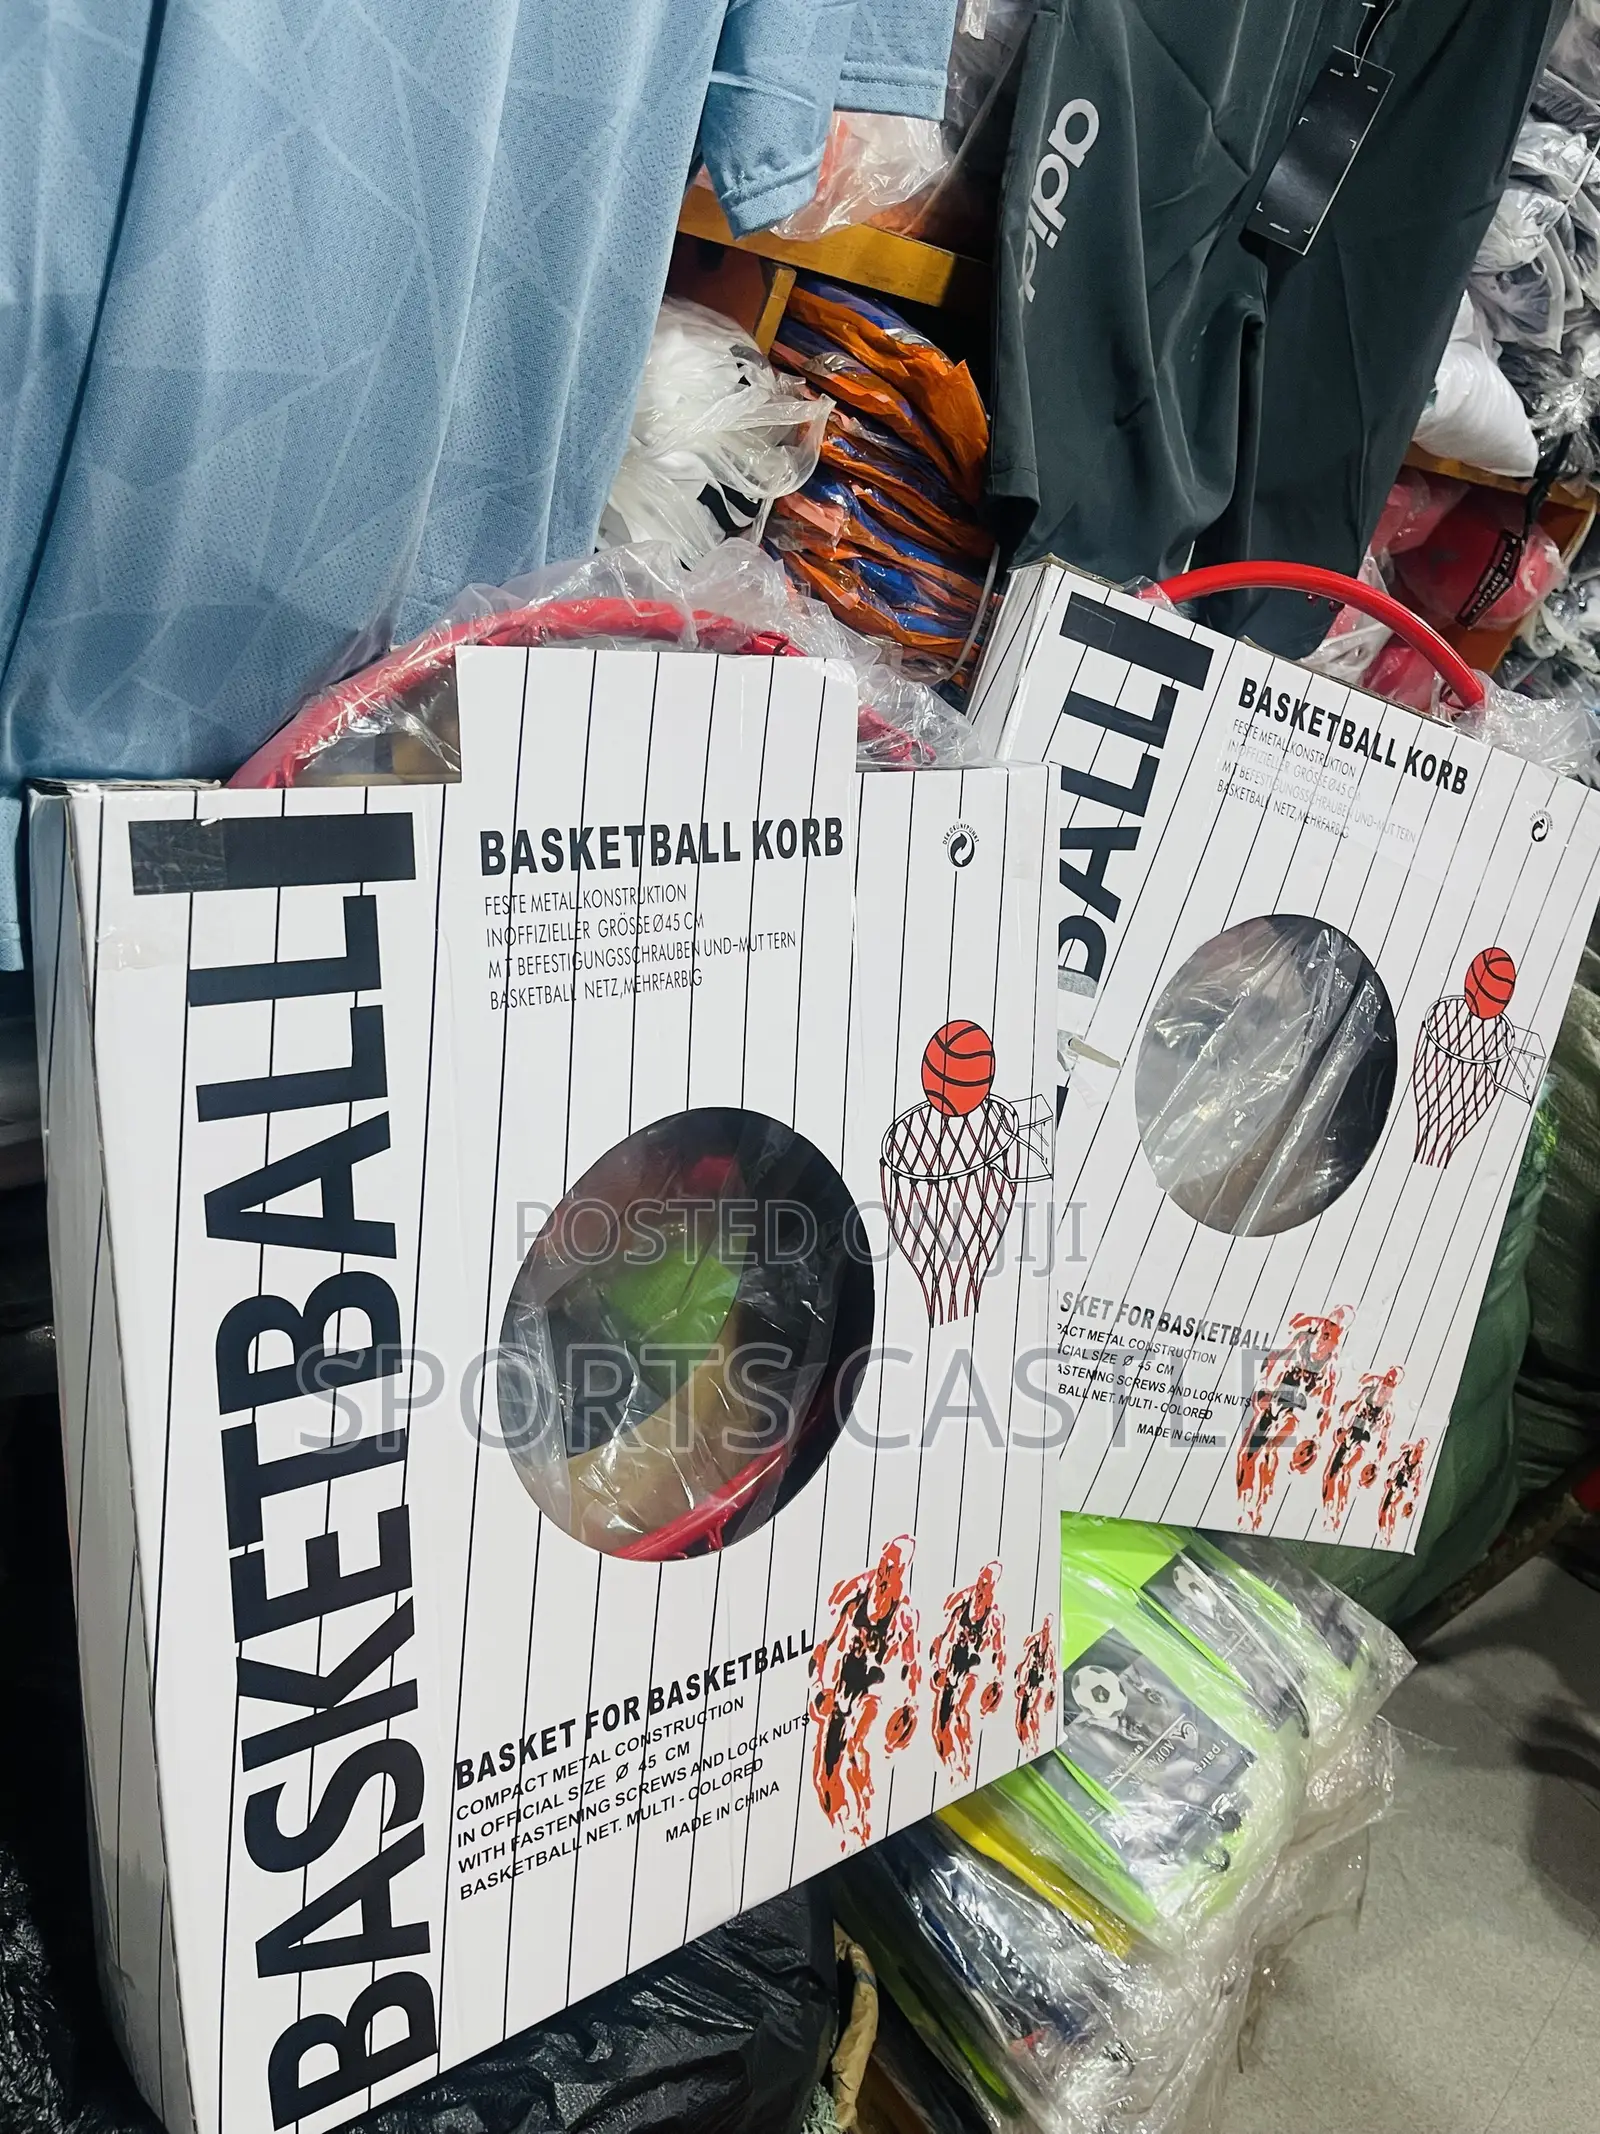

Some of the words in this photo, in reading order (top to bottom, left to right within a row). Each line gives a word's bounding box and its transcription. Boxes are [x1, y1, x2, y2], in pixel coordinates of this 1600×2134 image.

[1233, 718, 1258, 740] FESTE
[1258, 725, 1357, 779] METALLKONSTRUKTION
[1238, 677, 1397, 768] BASKETBALL
[1404, 745, 1468, 795] KORB
[1217, 779, 1270, 810] BASKETBALL
[480, 821, 741, 876] BASKETBALL
[753, 817, 843, 860] KORB
[485, 894, 527, 915] FESTE
[531, 884, 687, 913] METALLKONSTRUKTION
[487, 921, 591, 947] INOFFIZIELLER
[598, 912, 650, 938] GRÖSSE
[518, 938, 701, 977] BEFESTIGUNGSSCHRAUBEN
[490, 983, 577, 1010] BASKETBALL
[1057, 1290, 1114, 1320] SKET
[1115, 1303, 1155, 1329] FOR
[1158, 1311, 1272, 1352] BASKETBALL
[1087, 1330, 1126, 1348] METAL
[1128, 1338, 1217, 1365] CONSTRUCTION
[1091, 1350, 1119, 1365] SIZE
[1137, 1359, 1151, 1372] 45
[1156, 1363, 1175, 1376] CM
[1057, 1383, 1089, 1398] BALL
[1118, 1394, 1153, 1411] MULTI
[1160, 1402, 1213, 1421] COLORED
[1116, 1375, 1166, 1394] SCREWS
[1167, 1384, 1192, 1398] AND
[1192, 1390, 1221, 1403] LOCK
[1222, 1394, 1253, 1408] NUTS
[1137, 1423, 1170, 1440] MADE
[1171, 1428, 1183, 1441] IN
[1184, 1432, 1217, 1446] CHINA
[456, 1719, 576, 1791] BASKET
[585, 1696, 641, 1740] FOR
[649, 1629, 815, 1716] BASKETBALL
[456, 1772, 548, 1821] COMPACT
[552, 1750, 612, 1784] METAL
[615, 1696, 744, 1758] CONSTRUCTION
[1194, 1744, 1222, 1774] pairs
[457, 1829, 476, 1848] IN
[480, 1798, 565, 1837] OFFICIAL
[568, 1775, 606, 1801] SIZE
[638, 1754, 656, 1772] 45
[665, 1741, 691, 1762] CM
[458, 1842, 506, 1874] WITH
[510, 1800, 611, 1852] FASTENING
[615, 1770, 688, 1807] SCREWS
[690, 1754, 725, 1777] AND
[727, 1732, 770, 1760] LOCK
[772, 1713, 811, 1742] NUTS
[665, 1808, 713, 1843] MADE
[716, 1802, 731, 1821] IN
[734, 1780, 780, 1811] CHINA
[459, 1838, 583, 1901] BASKETBALL
[586, 1818, 623, 1846] NET.
[626, 1796, 676, 1827] MULTI
[688, 1758, 764, 1801] COLORED
